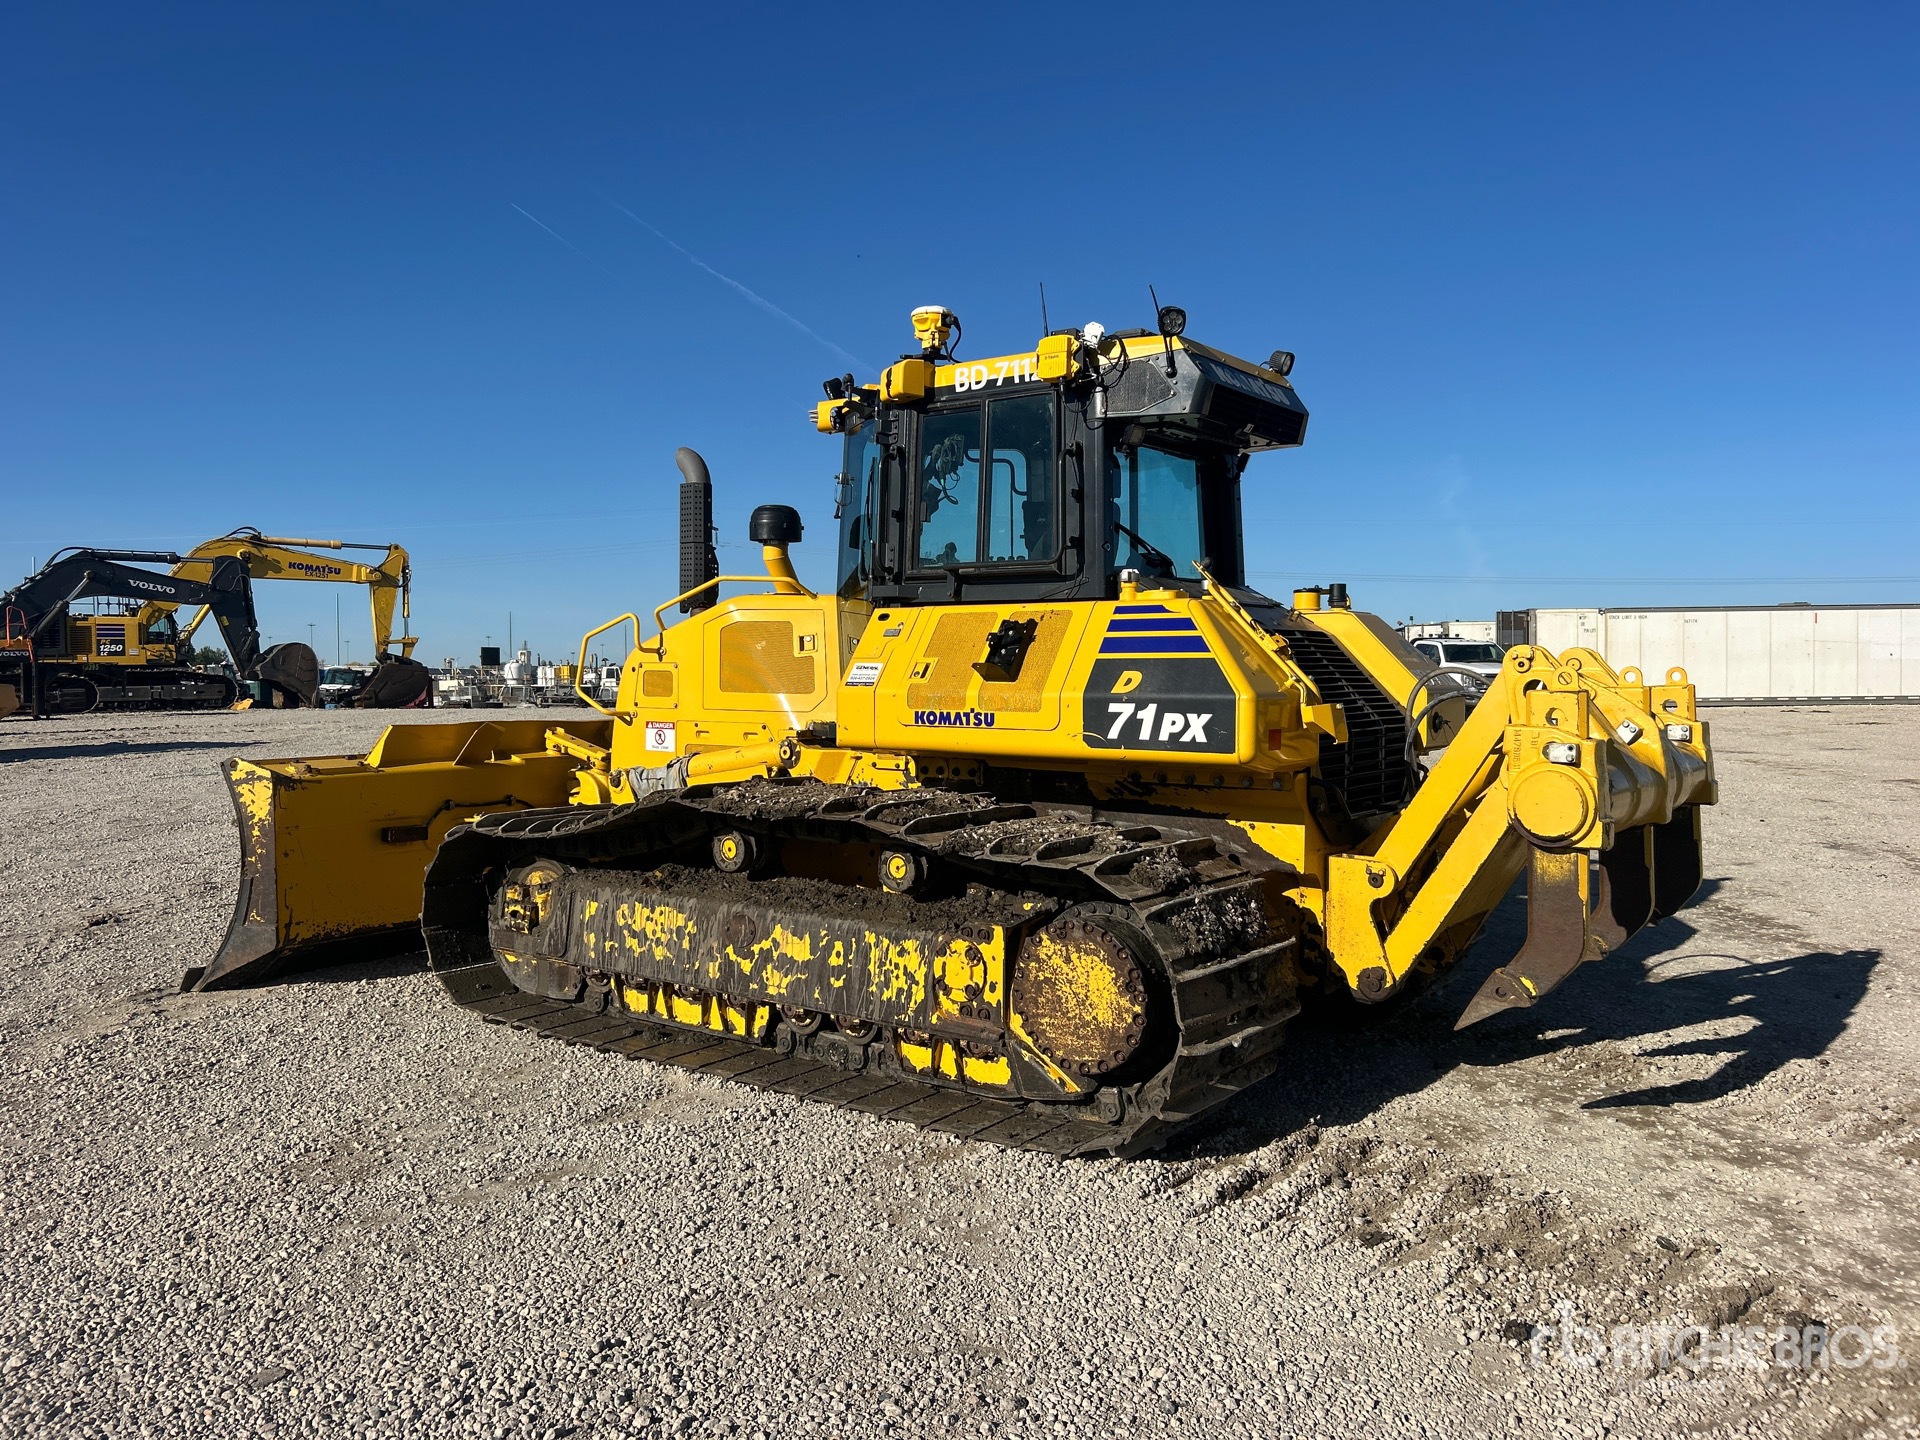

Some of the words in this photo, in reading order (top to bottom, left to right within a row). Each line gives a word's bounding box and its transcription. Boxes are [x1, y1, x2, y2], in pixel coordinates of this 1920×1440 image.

[1209, 362, 1291, 406] KOMATSU
[288, 561, 342, 575] KOMATSU
[128, 579, 176, 594] VOLVO
[99, 644, 123, 652] 1250
[1110, 670, 1143, 694] D
[914, 708, 995, 727] KOMATSU
[1106, 702, 1213, 743] 71PX
